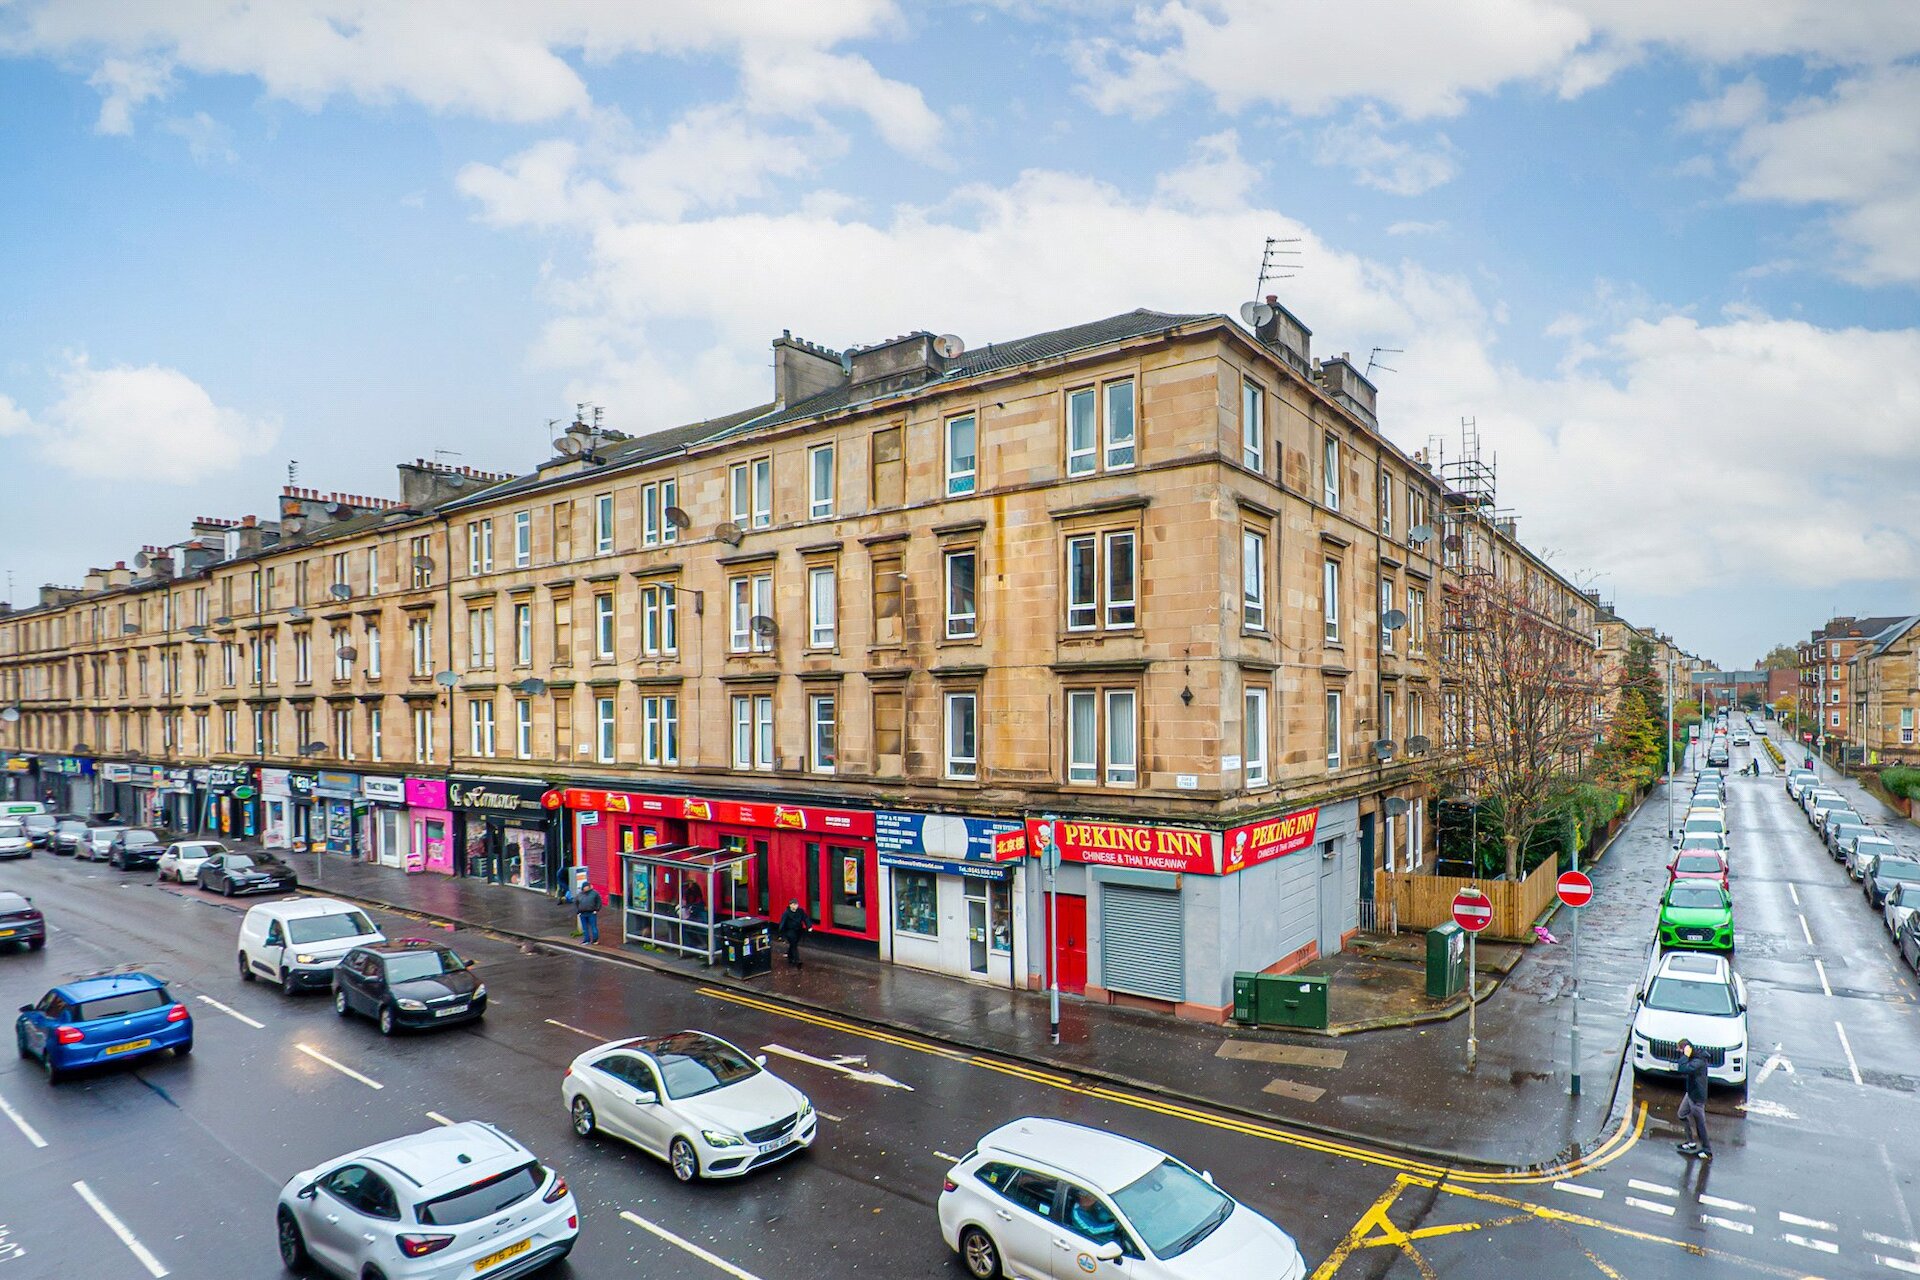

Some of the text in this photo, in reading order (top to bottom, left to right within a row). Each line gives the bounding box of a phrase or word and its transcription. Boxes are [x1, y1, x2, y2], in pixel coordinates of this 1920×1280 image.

[1064, 824, 1203, 857] PEKING INN
[1250, 812, 1316, 849] PEKING INN
[1082, 851, 1187, 870] CHINESE & THAI TAKEAWAY
[1257, 846, 1276, 860] CHINESE
[1279, 843, 1288, 852] THAI
[1288, 836, 1306, 849] TAKEAWAY
[478, 1241, 527, 1269] SF76 JZP
